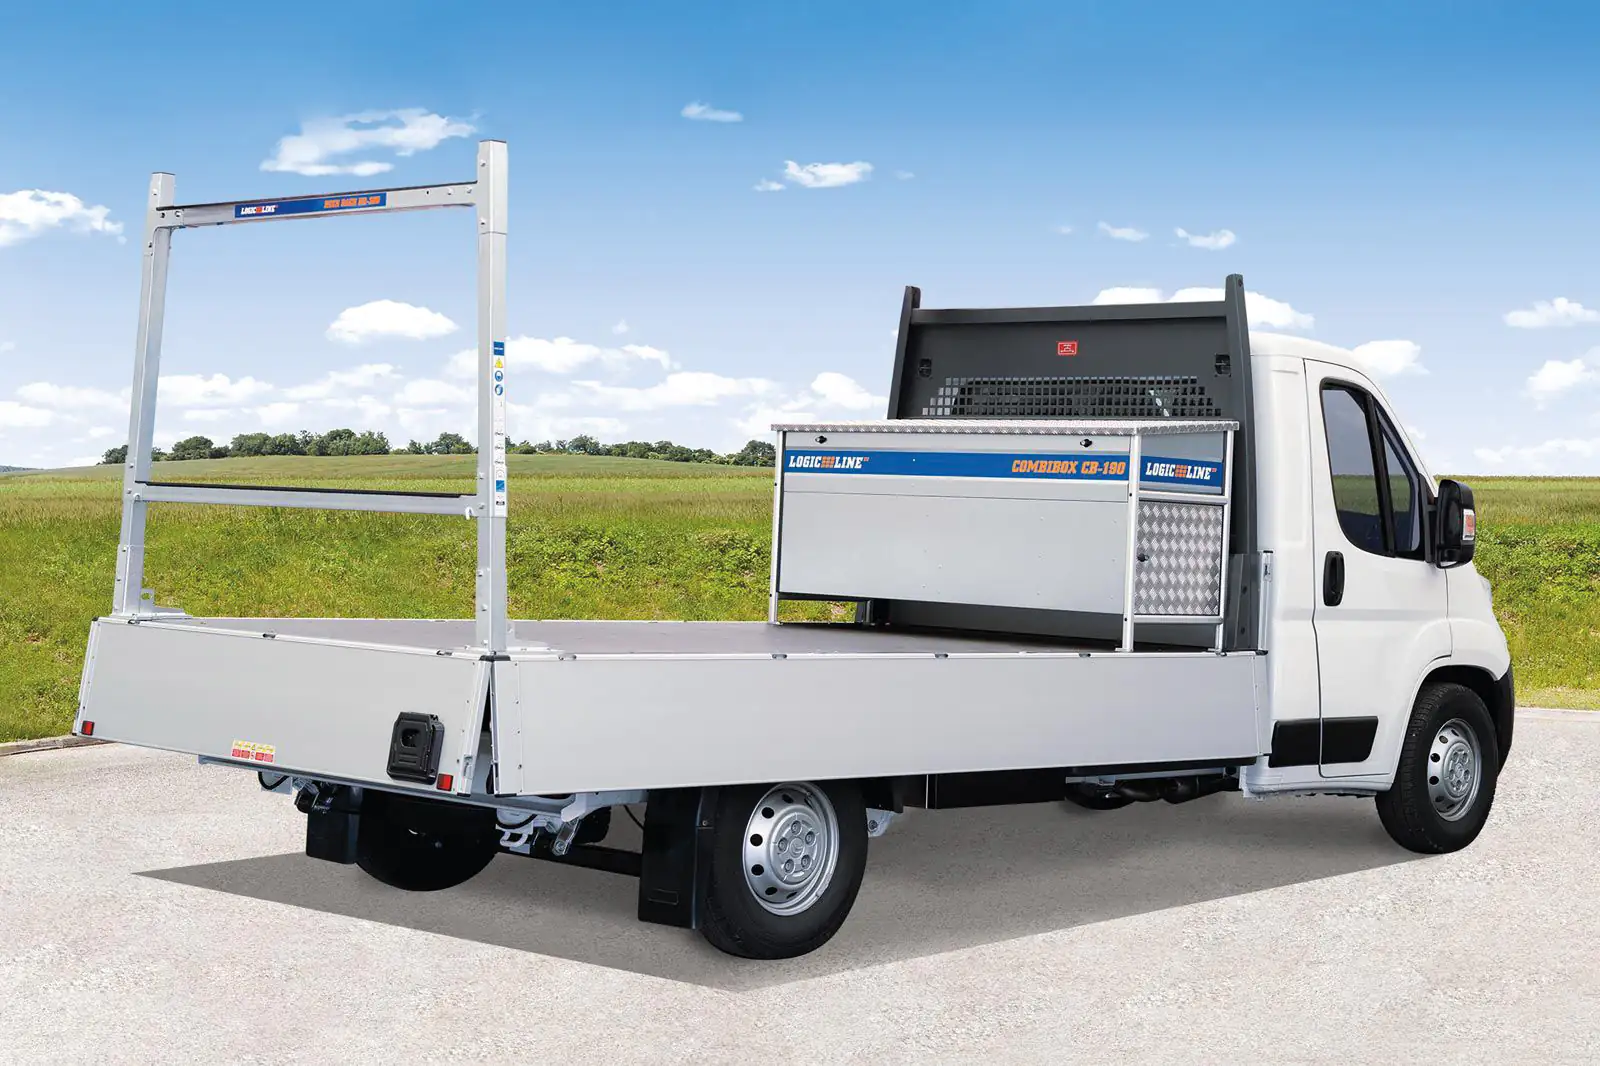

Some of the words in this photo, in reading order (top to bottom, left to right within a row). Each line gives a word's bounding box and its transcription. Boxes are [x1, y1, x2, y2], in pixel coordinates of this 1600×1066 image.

[788, 455, 822, 468] LOGIC
[834, 456, 863, 469] LINE
[1011, 460, 1078, 474] COMBIBOX
[1145, 462, 1176, 477] LOGIC
[1186, 465, 1212, 480] LINE
